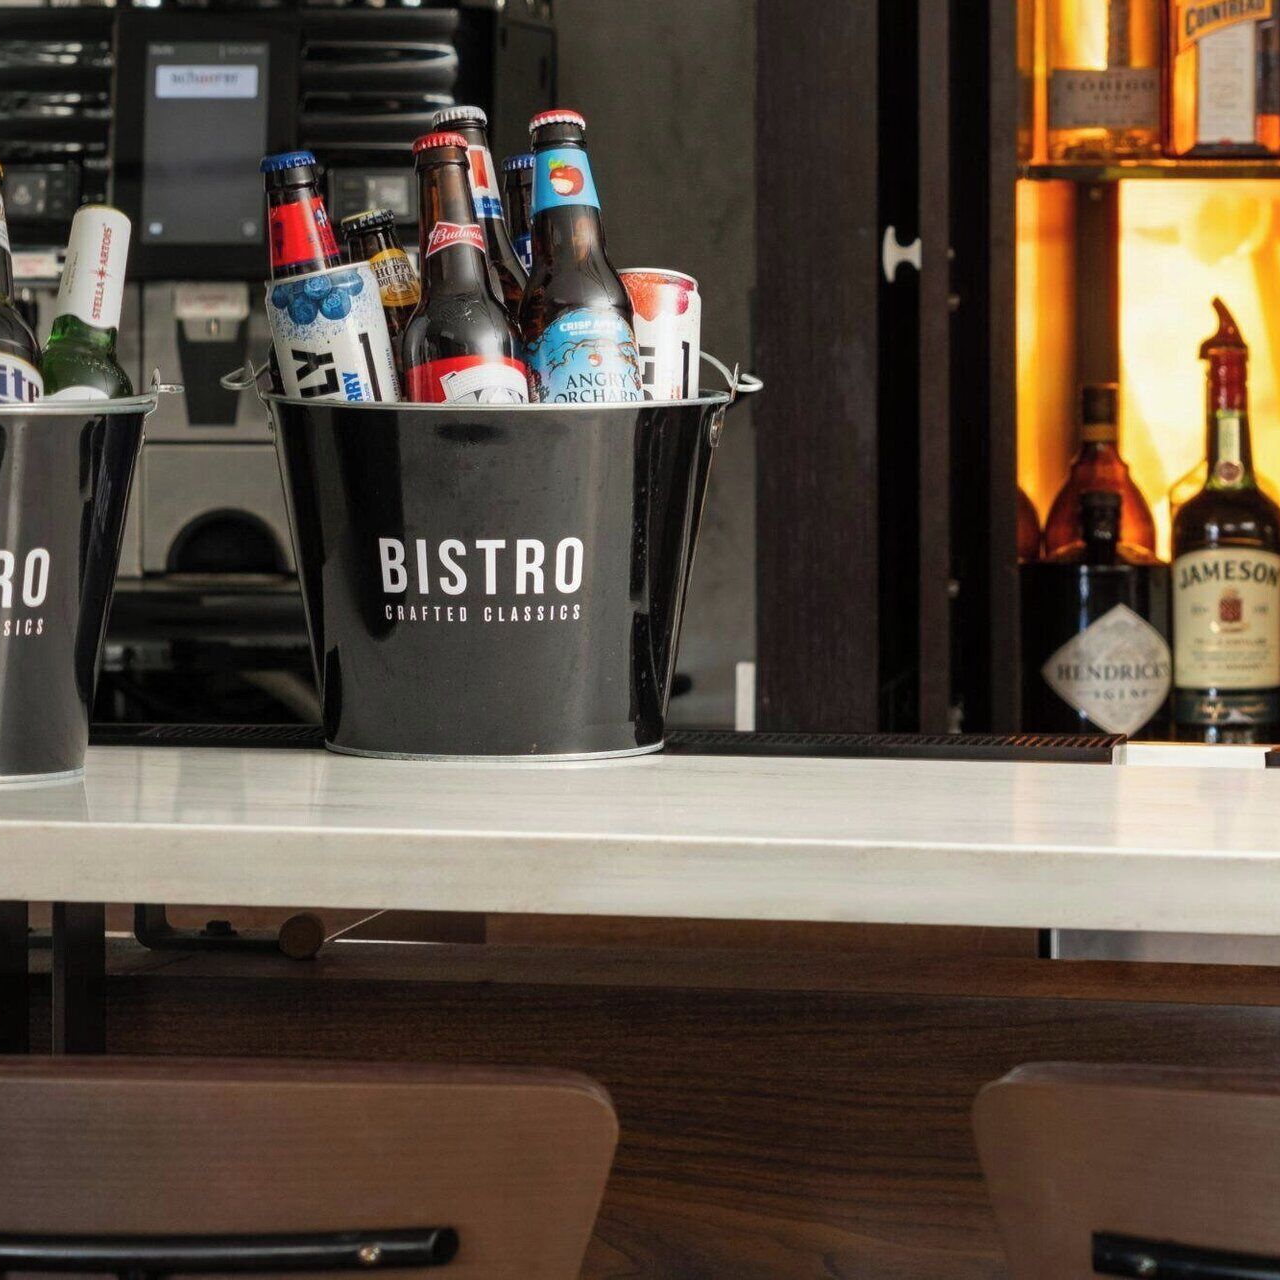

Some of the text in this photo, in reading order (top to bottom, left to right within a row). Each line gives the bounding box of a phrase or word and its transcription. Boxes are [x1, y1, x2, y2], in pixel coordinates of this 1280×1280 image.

[559, 320, 592, 332] CRISP
[566, 372, 628, 390] ANGRY
[554, 388, 639, 403] ORCHARD
[379, 537, 584, 596] BISTRO
[1180, 560, 1280, 589] JAMESON
[385, 604, 581, 622] CRAFTED CLASSICS
